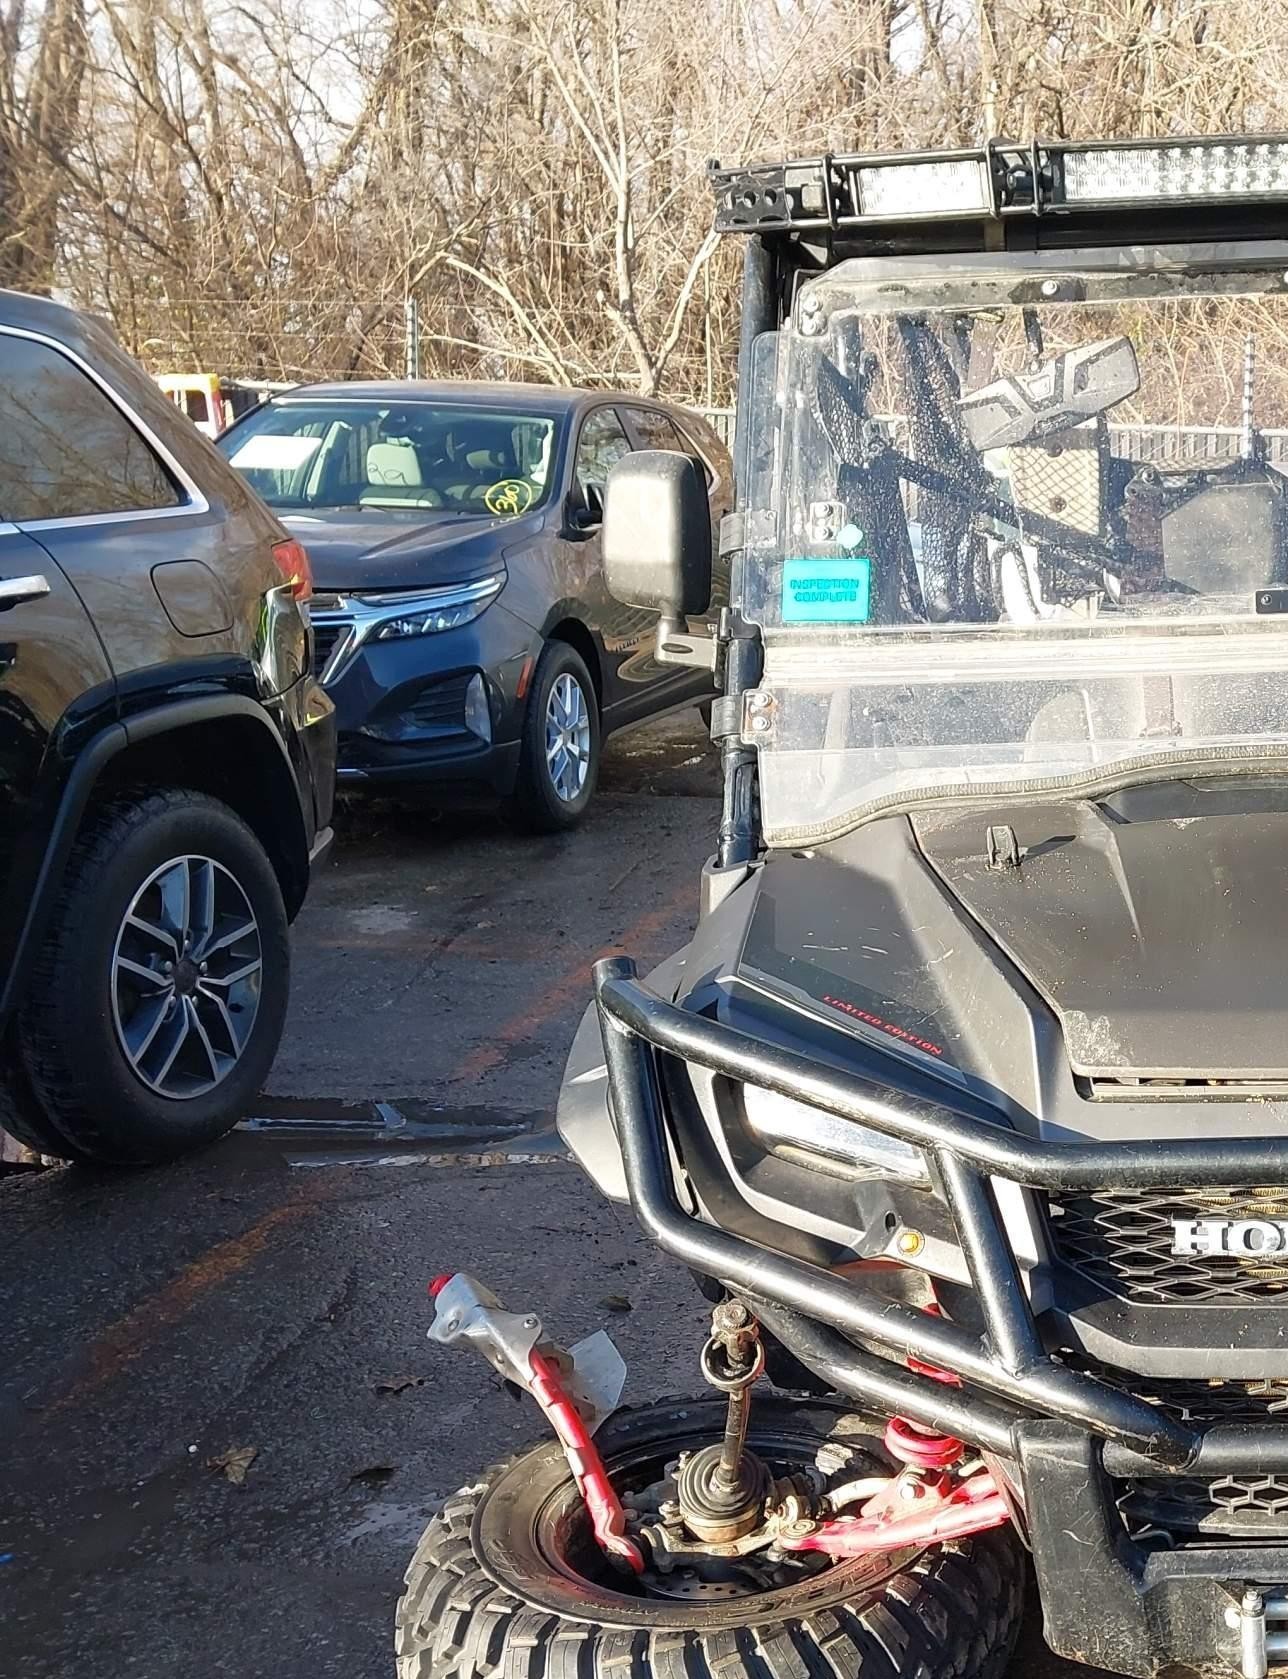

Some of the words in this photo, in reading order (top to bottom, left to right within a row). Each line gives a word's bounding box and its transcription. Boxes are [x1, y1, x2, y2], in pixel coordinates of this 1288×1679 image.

[790, 578, 860, 590] INSPECTION
[794, 591, 857, 603] COMPLETE
[822, 994, 883, 1026] LIMITED
[884, 1022, 943, 1056] EDITION
